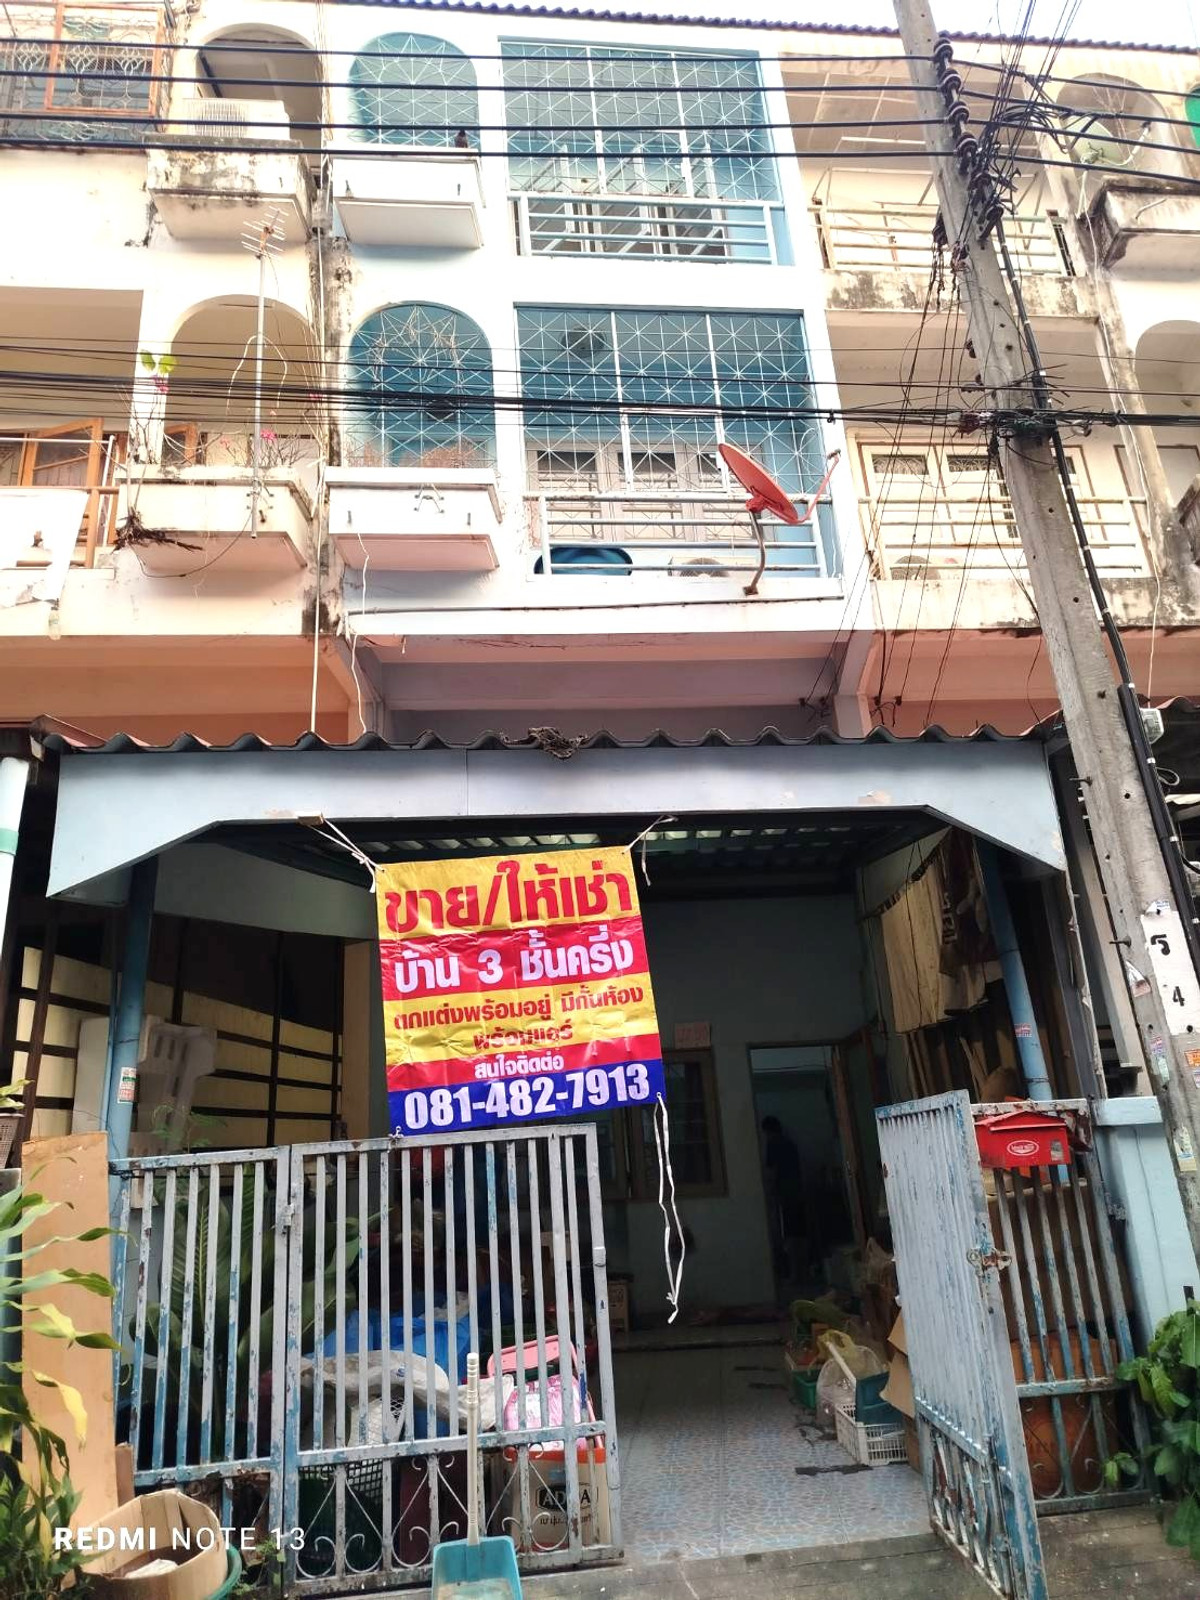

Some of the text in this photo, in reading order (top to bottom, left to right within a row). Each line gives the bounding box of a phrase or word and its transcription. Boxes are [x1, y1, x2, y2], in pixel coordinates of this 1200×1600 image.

[385, 860, 632, 933] ขาย/ให้เช่า
[1150, 934, 1171, 955] 5
[394, 950, 460, 993] บ้าน
[477, 949, 504, 984] 3
[394, 985, 644, 1030] ตกแต่งพร้อมอยู่ มีกั้นห้อง
[1172, 986, 1185, 1006] 4
[474, 1051, 565, 1079] สนใจติดต่อ
[404, 1063, 650, 1129] 081-482-7913
[542, 1488, 591, 1507] ADA
